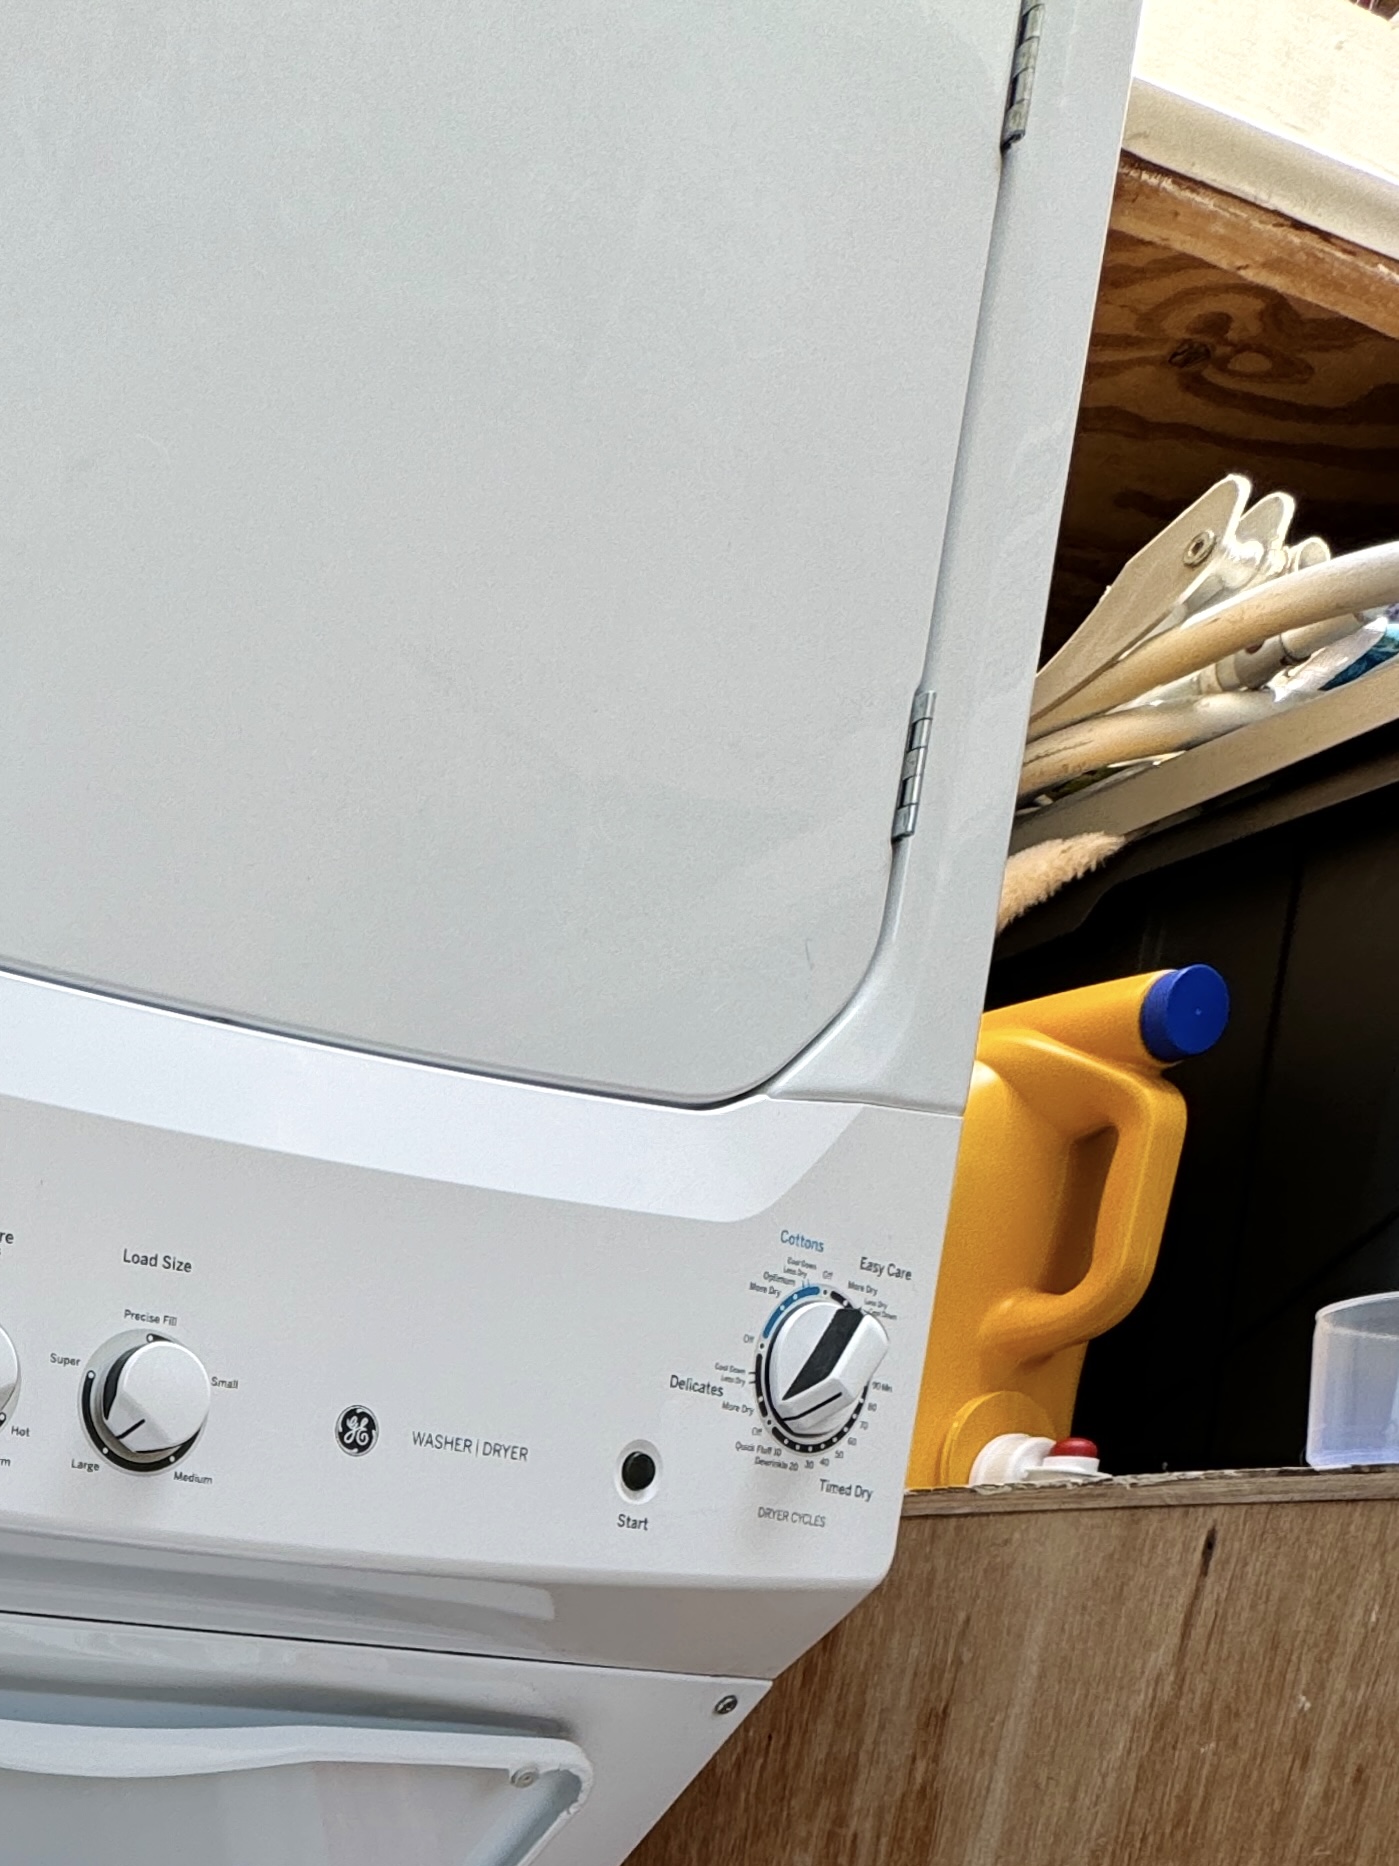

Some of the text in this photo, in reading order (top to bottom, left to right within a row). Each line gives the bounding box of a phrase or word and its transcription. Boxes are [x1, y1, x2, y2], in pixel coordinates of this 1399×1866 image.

[780, 1230, 825, 1252] Cottons
[123, 1248, 192, 1273] Load Size
[859, 1257, 912, 1281] Easy Care
[124, 1309, 177, 1326] Precise Fill
[49, 1353, 81, 1367] Super
[211, 1377, 239, 1390] Small
[669, 1374, 724, 1397] Delicates
[11, 1425, 31, 1438] Hot
[860, 1421, 868, 1430] 70
[412, 1431, 529, 1462] WASHER DRYER
[834, 1450, 844, 1459] 50
[71, 1459, 100, 1473] Large
[173, 1471, 213, 1486] Medium
[819, 1479, 874, 1502] Timed Dry
[617, 1514, 649, 1531] Start
[758, 1506, 826, 1528] DRYER CYCLES
